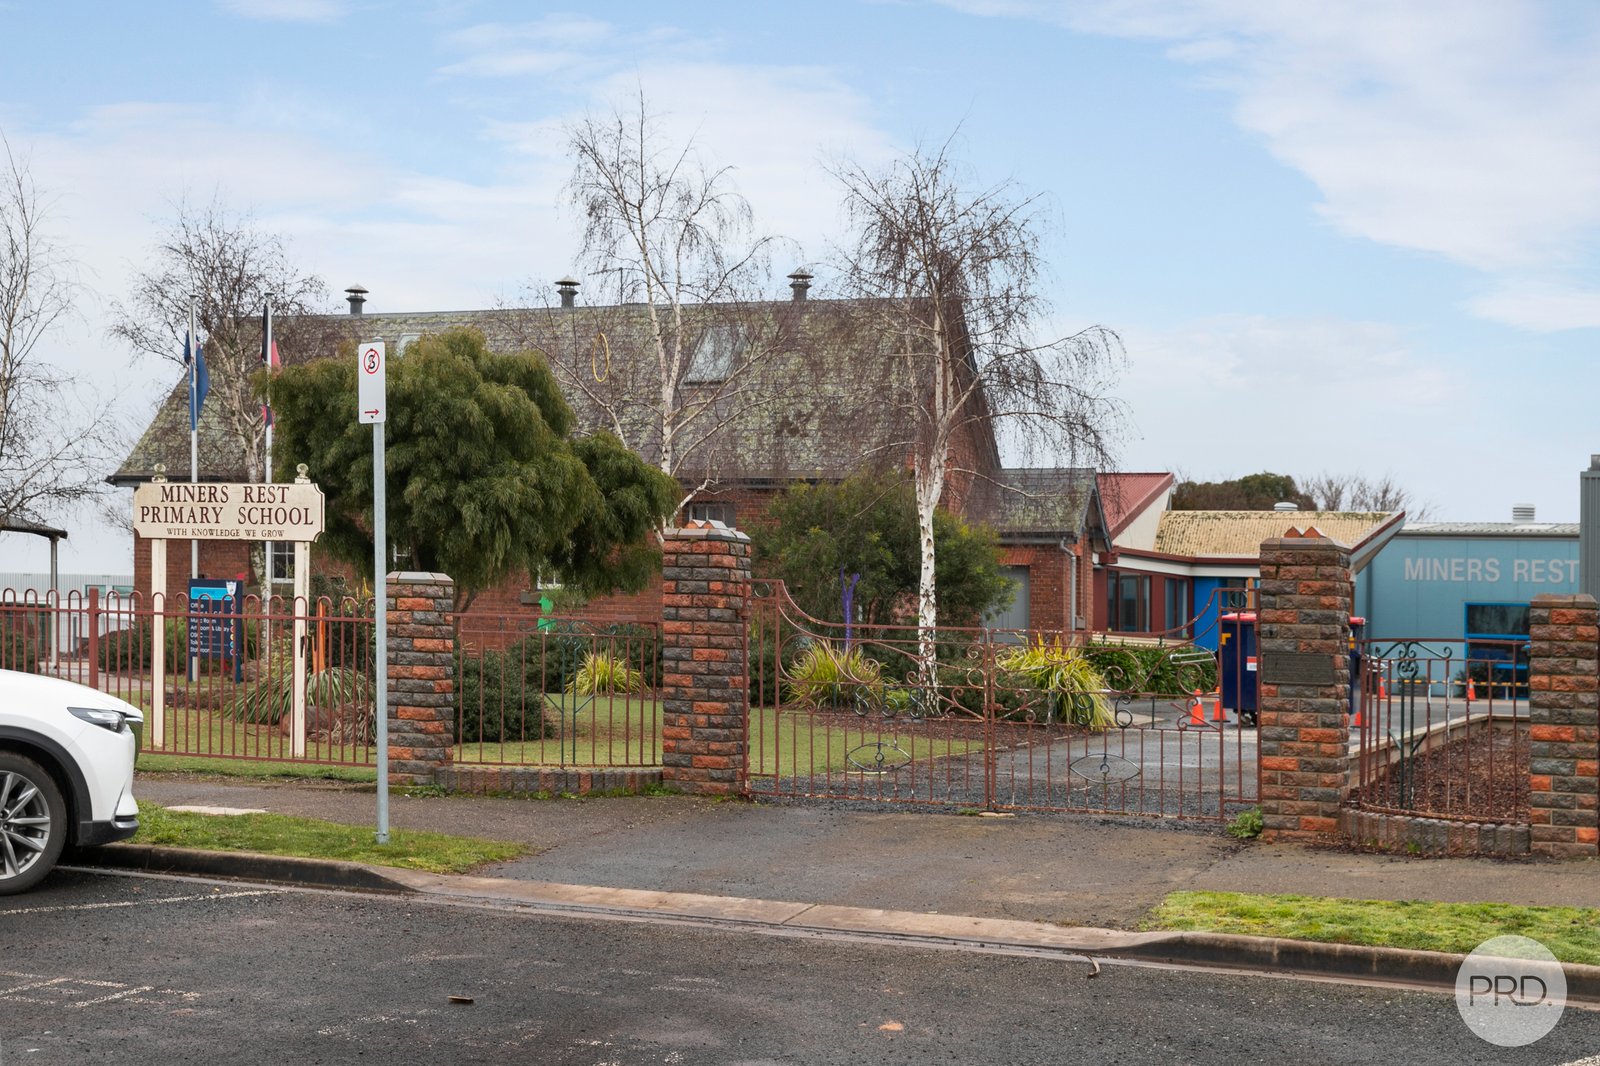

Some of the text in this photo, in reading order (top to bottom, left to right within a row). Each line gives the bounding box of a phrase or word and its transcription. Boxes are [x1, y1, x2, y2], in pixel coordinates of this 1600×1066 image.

[161, 485, 290, 503] MINERS REST
[140, 505, 314, 525] PRIMARY SCHOOL
[166, 528, 285, 537] WITH KNOWLEDGE WE GROW
[1404, 557, 1580, 583] MINERS REST
